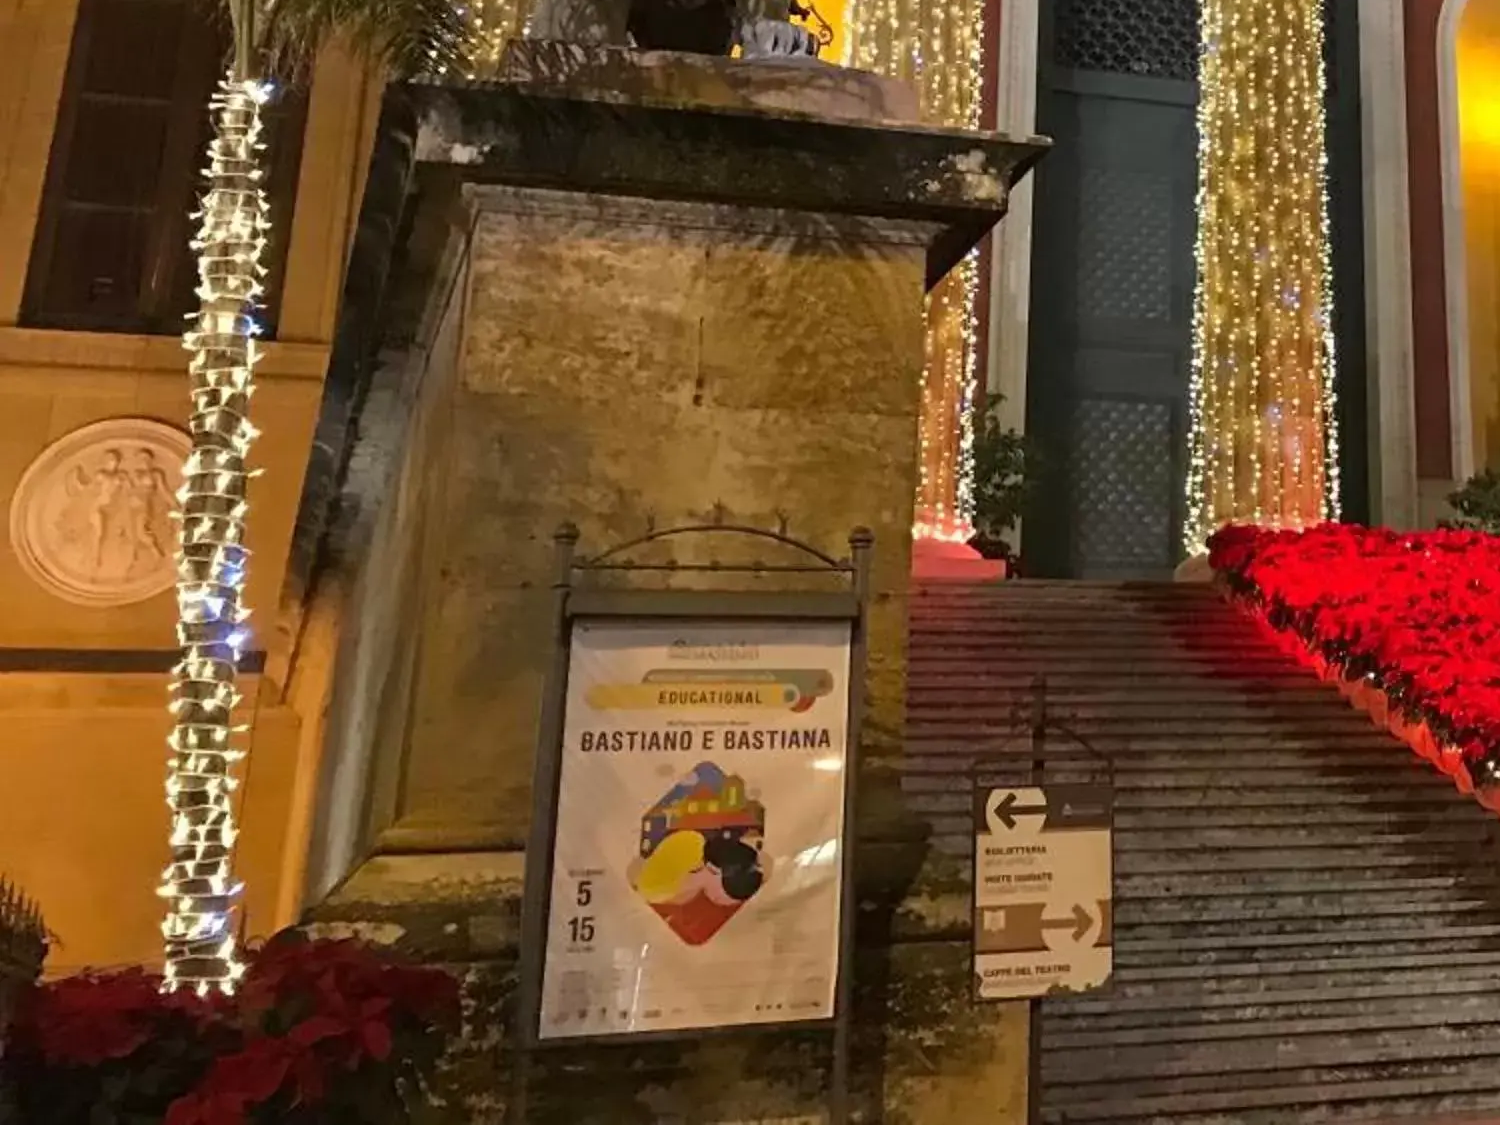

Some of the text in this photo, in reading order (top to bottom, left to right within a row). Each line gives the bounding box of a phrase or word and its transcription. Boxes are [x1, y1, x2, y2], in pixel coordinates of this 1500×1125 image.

[657, 690, 763, 705] EDUCATIONAL
[580, 728, 832, 752] BASTIANO E BASTIANA
[576, 880, 593, 907] 5
[567, 916, 596, 943] 15
